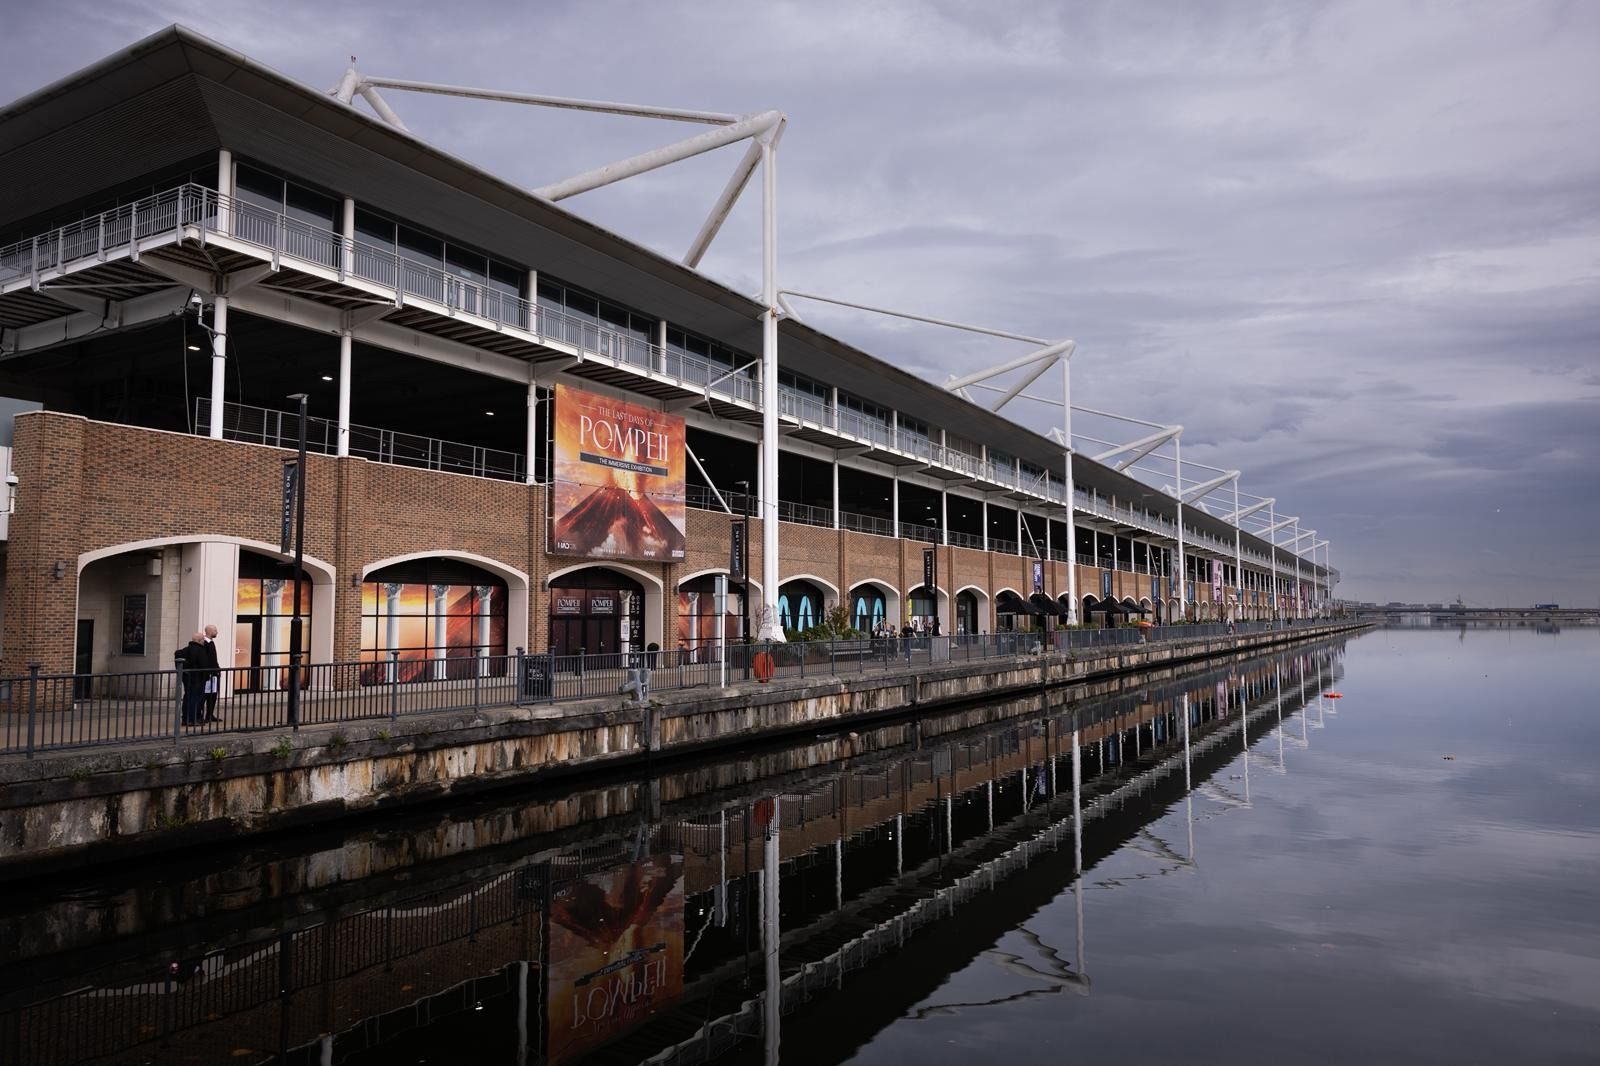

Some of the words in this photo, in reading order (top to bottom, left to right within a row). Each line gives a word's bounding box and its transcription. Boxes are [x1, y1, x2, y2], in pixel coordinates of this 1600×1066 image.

[598, 406, 611, 416] THE
[612, 409, 627, 420] LAST
[628, 414, 644, 426] DAYS
[644, 418, 654, 426] OF
[580, 415, 668, 462] POMPEII
[599, 457, 608, 465] THE
[608, 459, 631, 469] IMMERSIVE
[631, 463, 653, 473] EXHIBITION
[557, 599, 580, 607] POMPEII
[592, 599, 613, 607] POMPEII
